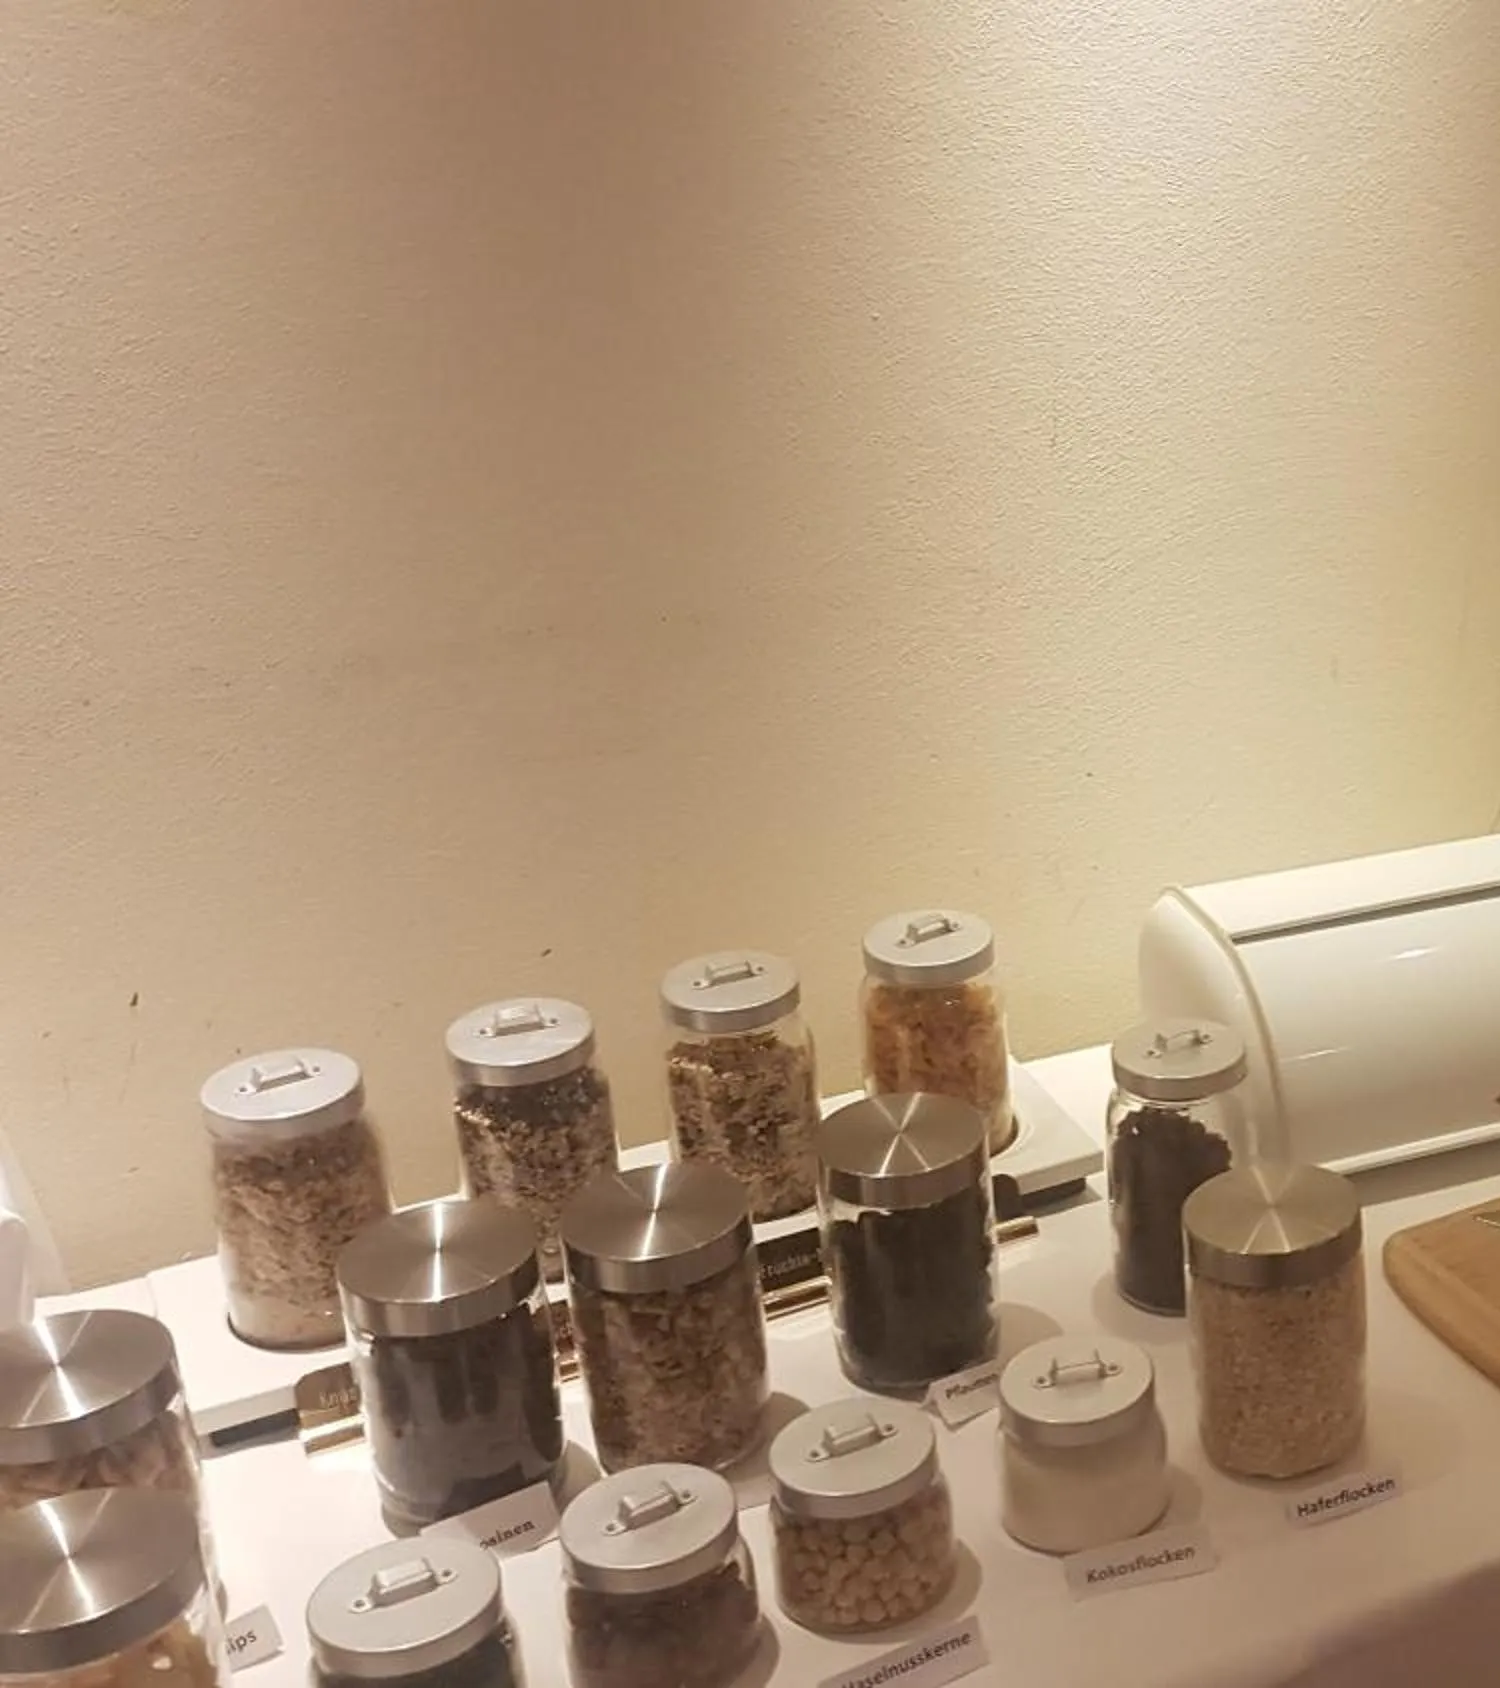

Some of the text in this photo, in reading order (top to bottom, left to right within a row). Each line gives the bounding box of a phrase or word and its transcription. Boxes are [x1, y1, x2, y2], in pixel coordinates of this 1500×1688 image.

[1297, 1478, 1396, 1517] Haferflocken
[1086, 1546, 1196, 1583] Kokosflocken
[227, 1629, 257, 1654] ips
